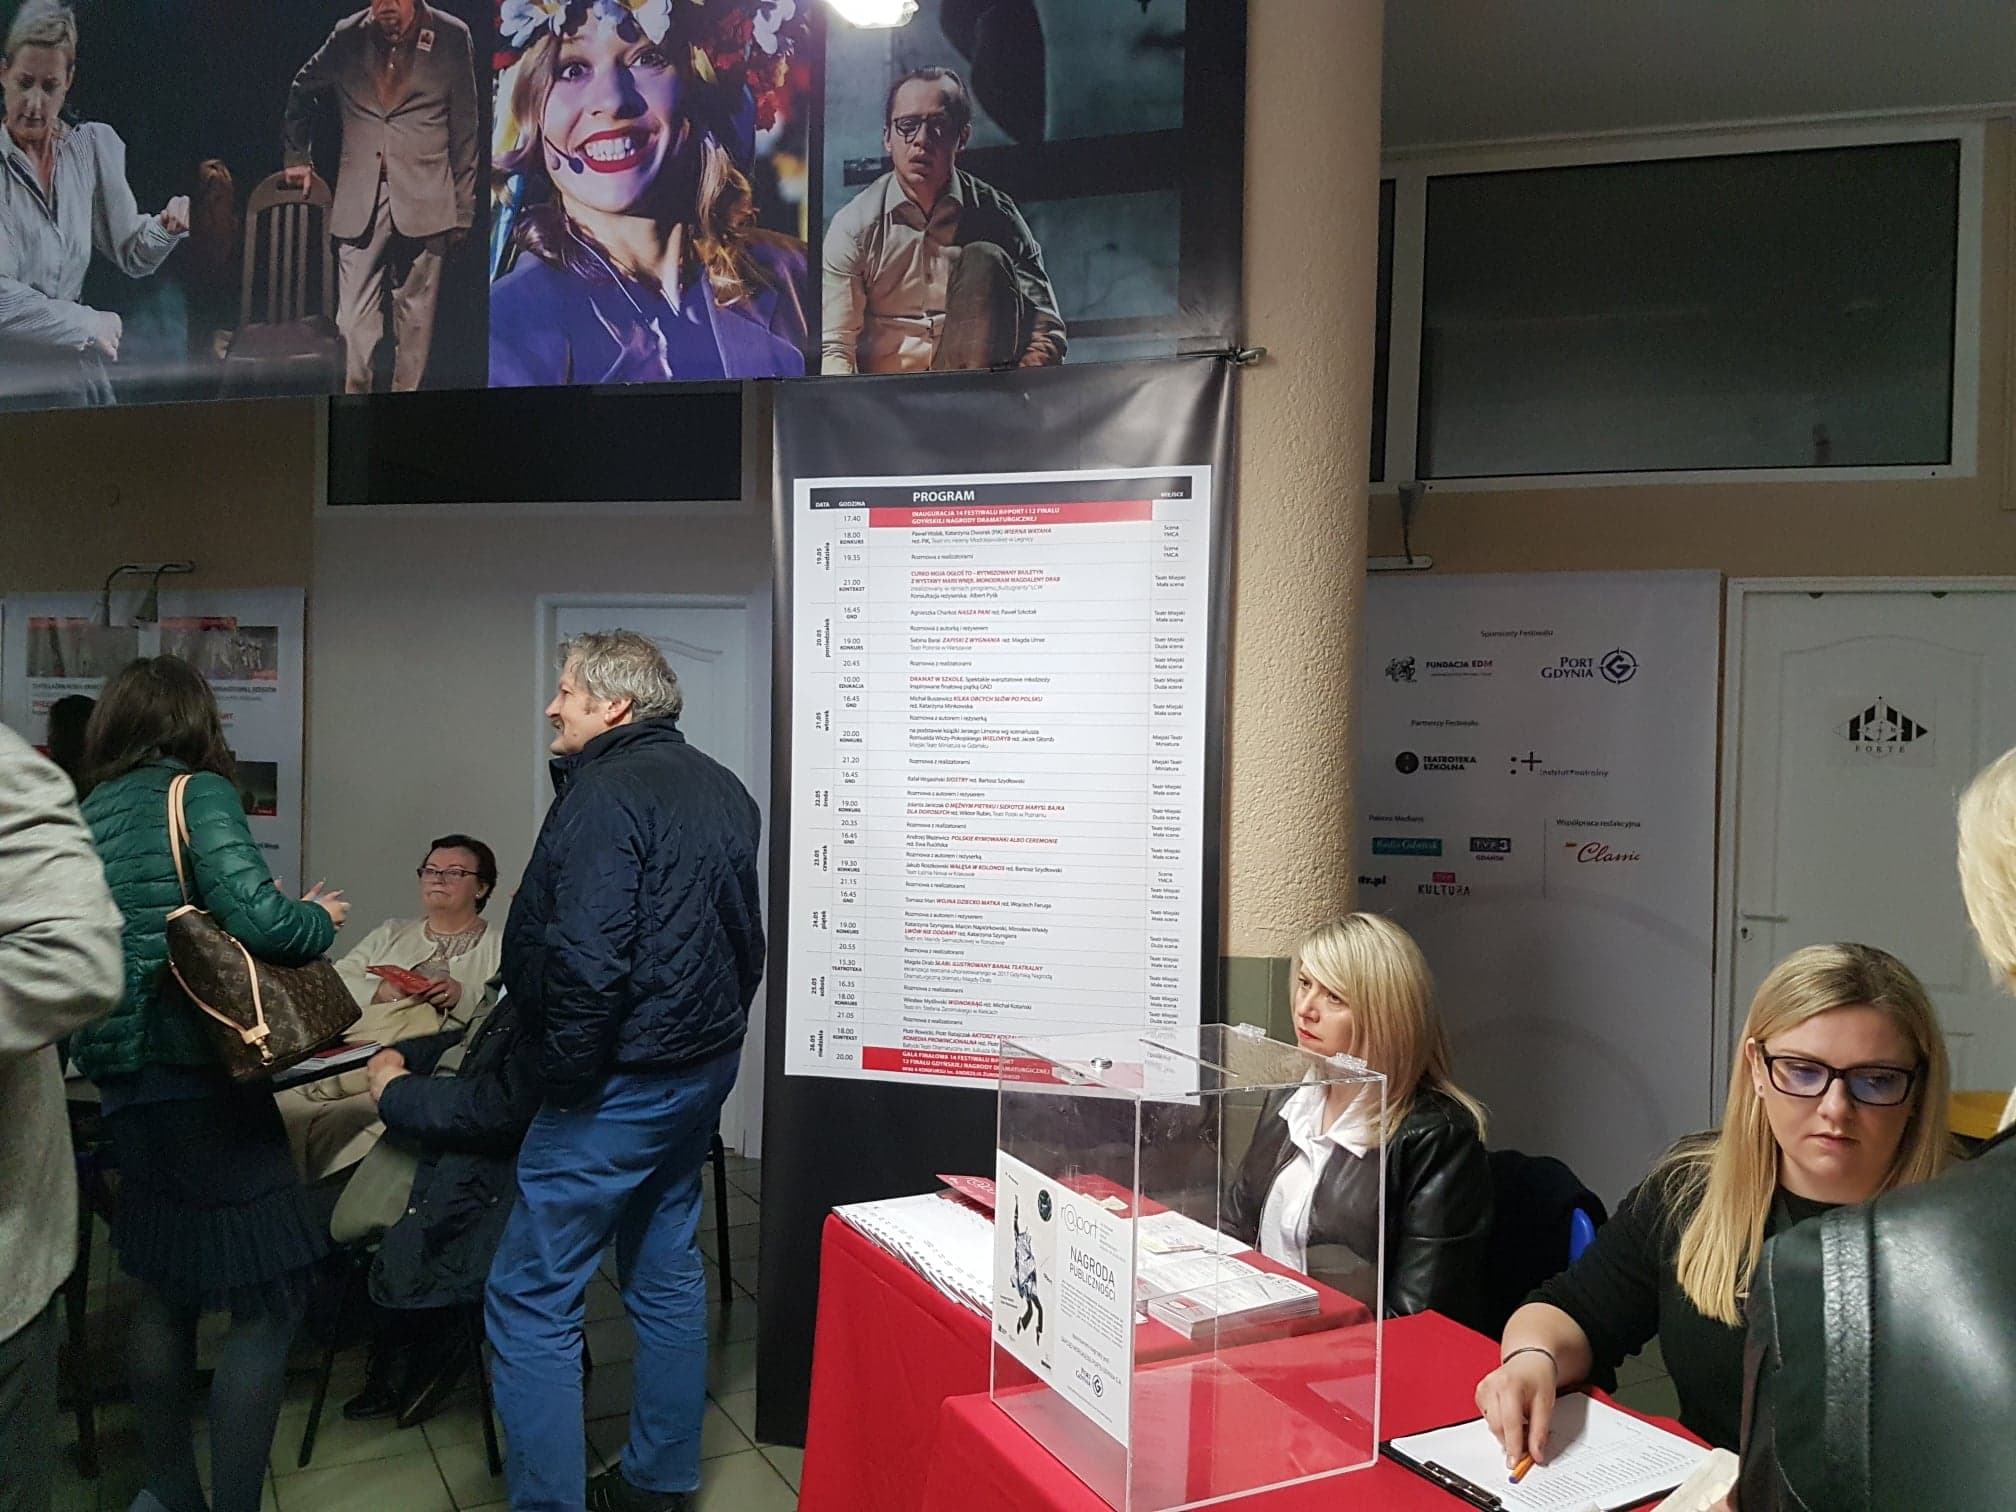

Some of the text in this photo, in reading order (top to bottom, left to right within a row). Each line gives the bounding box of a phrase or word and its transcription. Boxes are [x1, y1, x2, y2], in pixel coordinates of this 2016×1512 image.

[913, 491, 975, 502] PROGRAM
[1560, 657, 1593, 668] PORT
[1541, 668, 1593, 678] GDYNIA
[1424, 756, 1476, 764] TEATROTEKA
[1578, 842, 1640, 863] Classic
[1418, 885, 1470, 896] KULTURA
[1071, 1246, 1115, 1287] NAGRODA
[1070, 1262, 1116, 1303] PUBLICZNOŚCI
